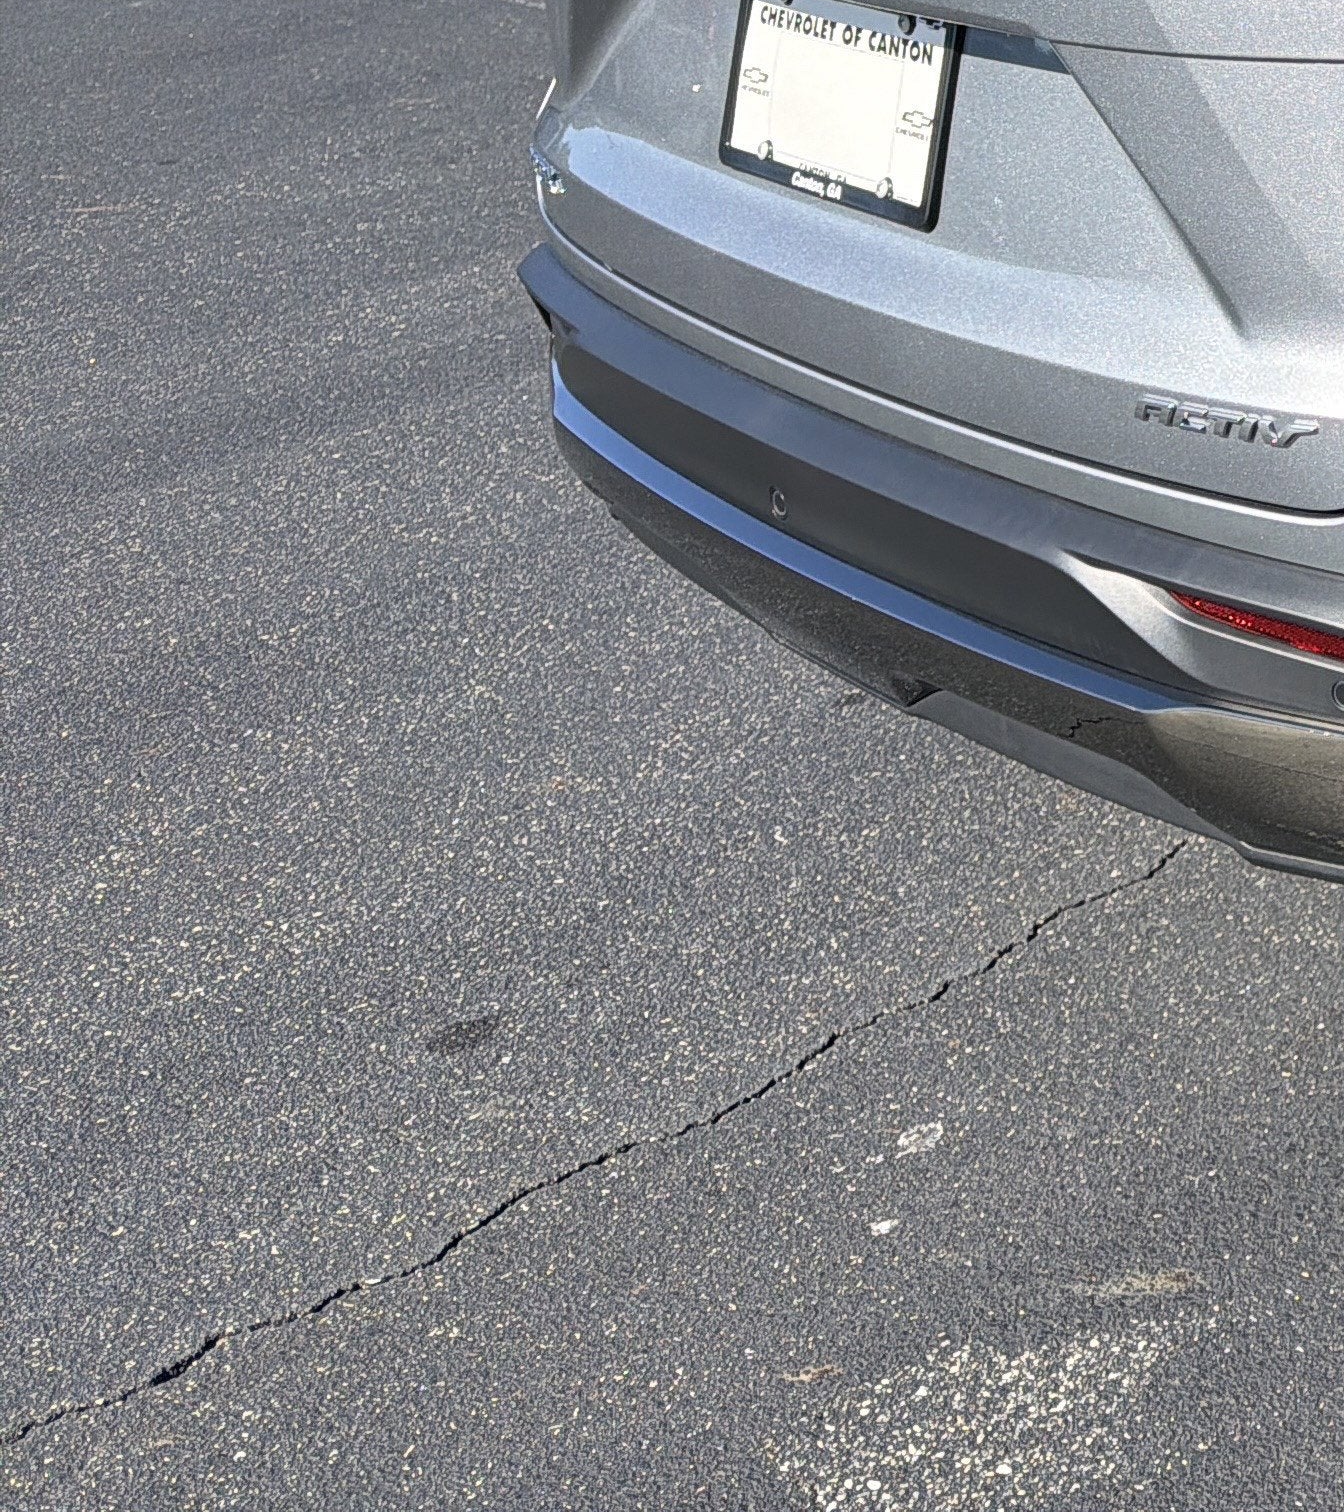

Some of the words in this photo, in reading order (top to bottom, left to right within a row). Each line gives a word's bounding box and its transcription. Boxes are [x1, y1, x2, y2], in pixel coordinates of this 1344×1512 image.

[760, 4, 837, 41] CHEVROLET
[842, 24, 864, 47] OF
[868, 31, 934, 66] CANTON
[1133, 392, 1321, 449] ACTIV
